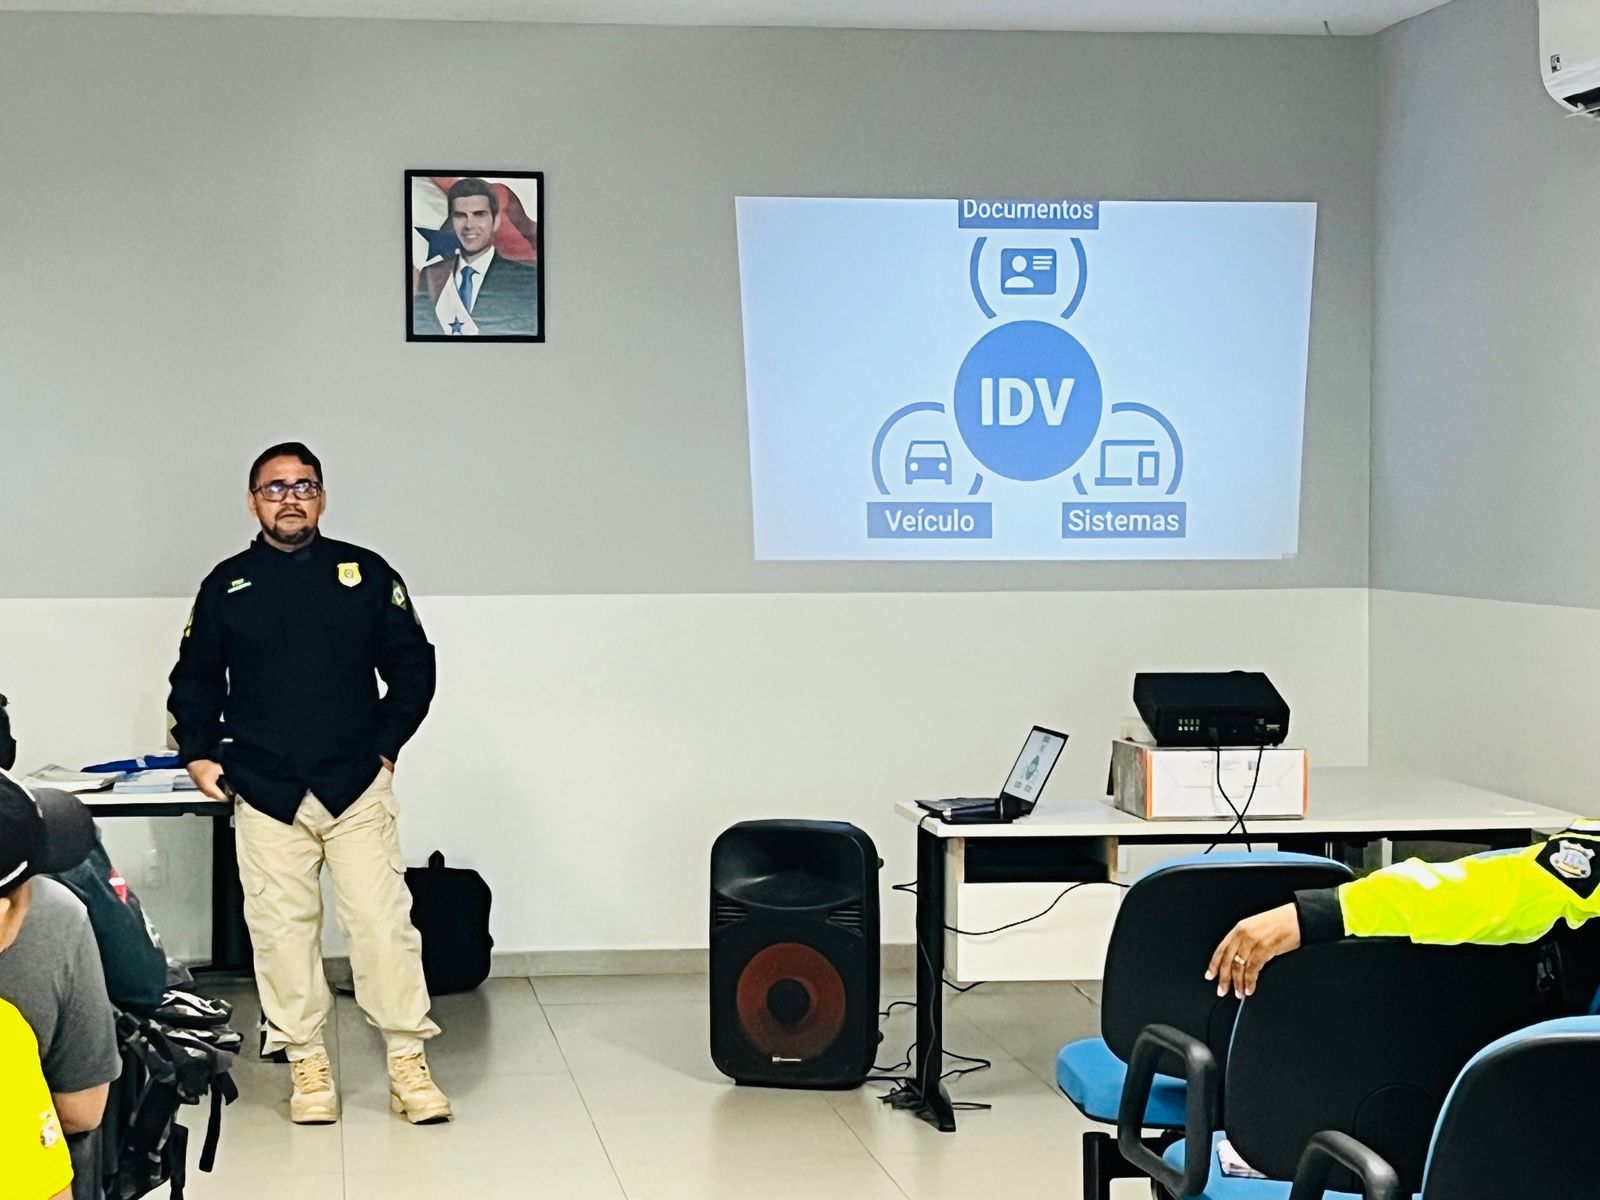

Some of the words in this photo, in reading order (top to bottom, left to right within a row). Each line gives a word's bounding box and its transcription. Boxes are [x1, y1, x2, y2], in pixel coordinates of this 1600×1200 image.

[963, 199, 1094, 219] Documentos
[981, 378, 1075, 426] IDV
[884, 508, 975, 532] Veículo
[1068, 509, 1180, 532] Sistemas
